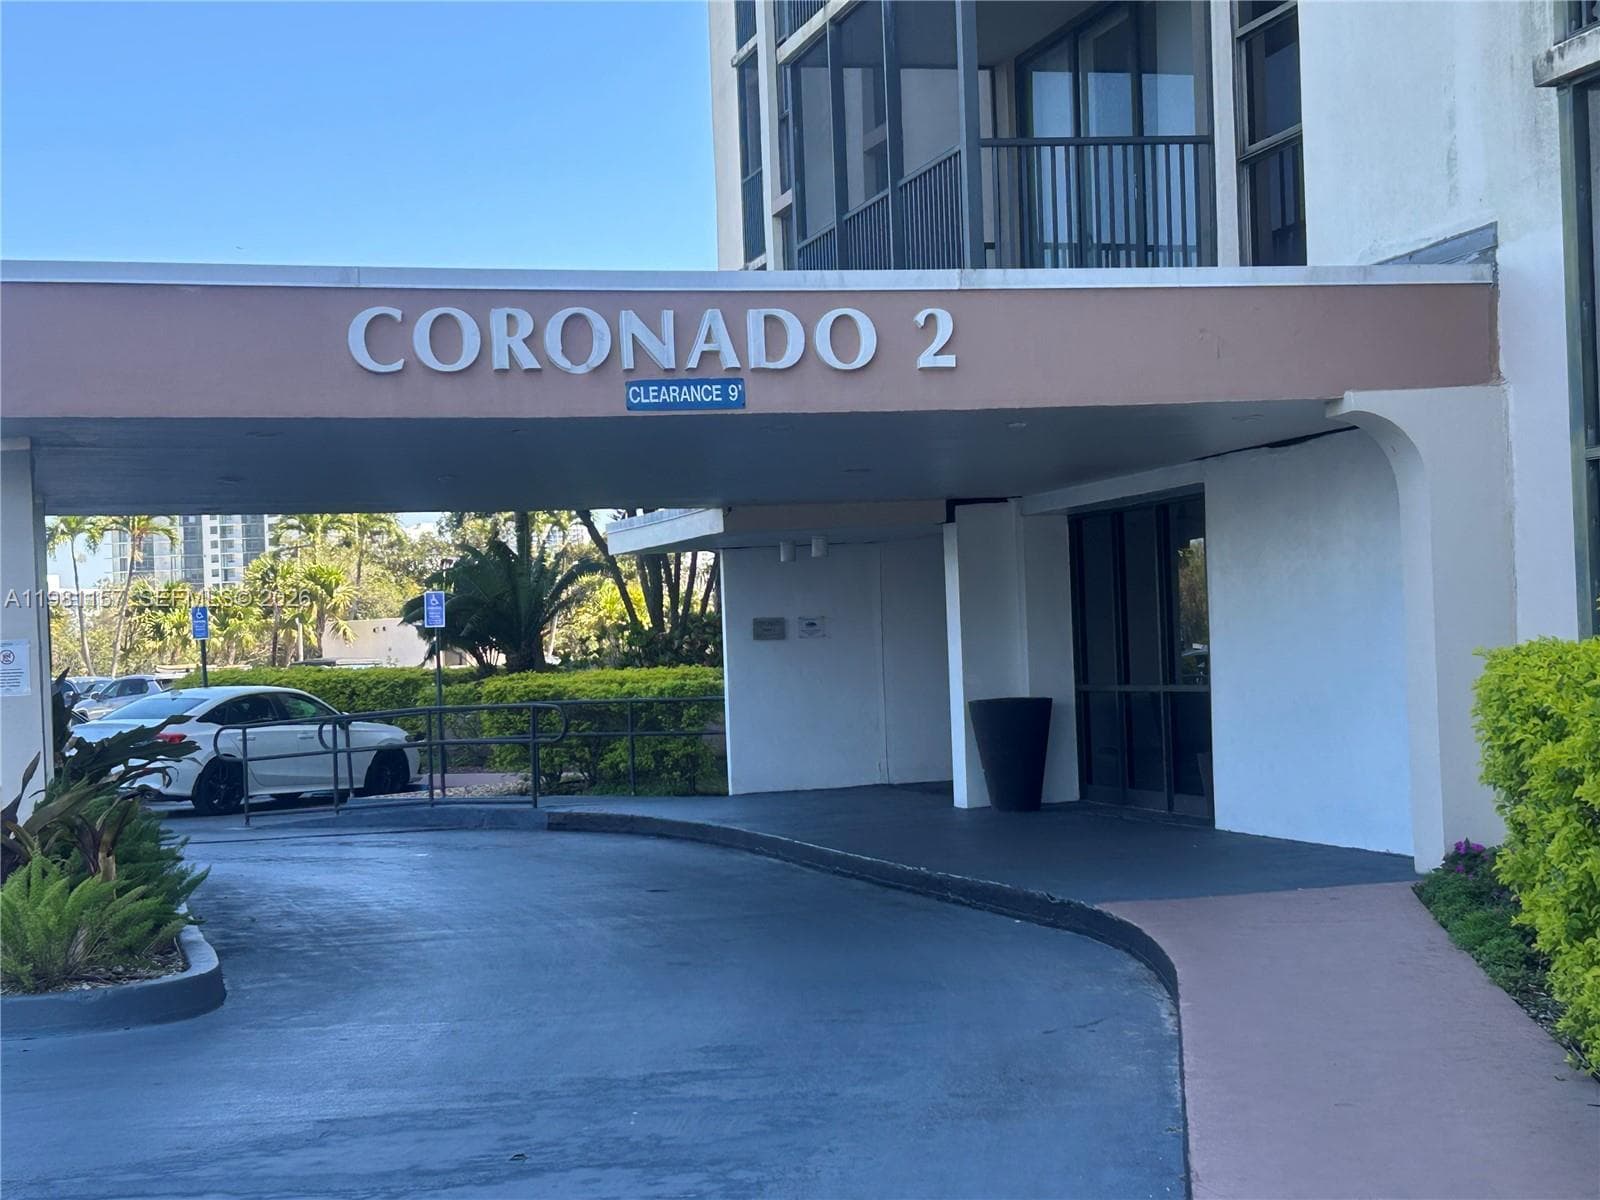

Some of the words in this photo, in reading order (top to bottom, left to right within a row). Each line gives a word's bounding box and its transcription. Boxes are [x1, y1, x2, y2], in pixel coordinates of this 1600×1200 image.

[348, 306, 877, 373] CORONADO
[915, 308, 958, 369] 2
[628, 385, 723, 404] CLEARANCE
[728, 384, 743, 401] 9'
